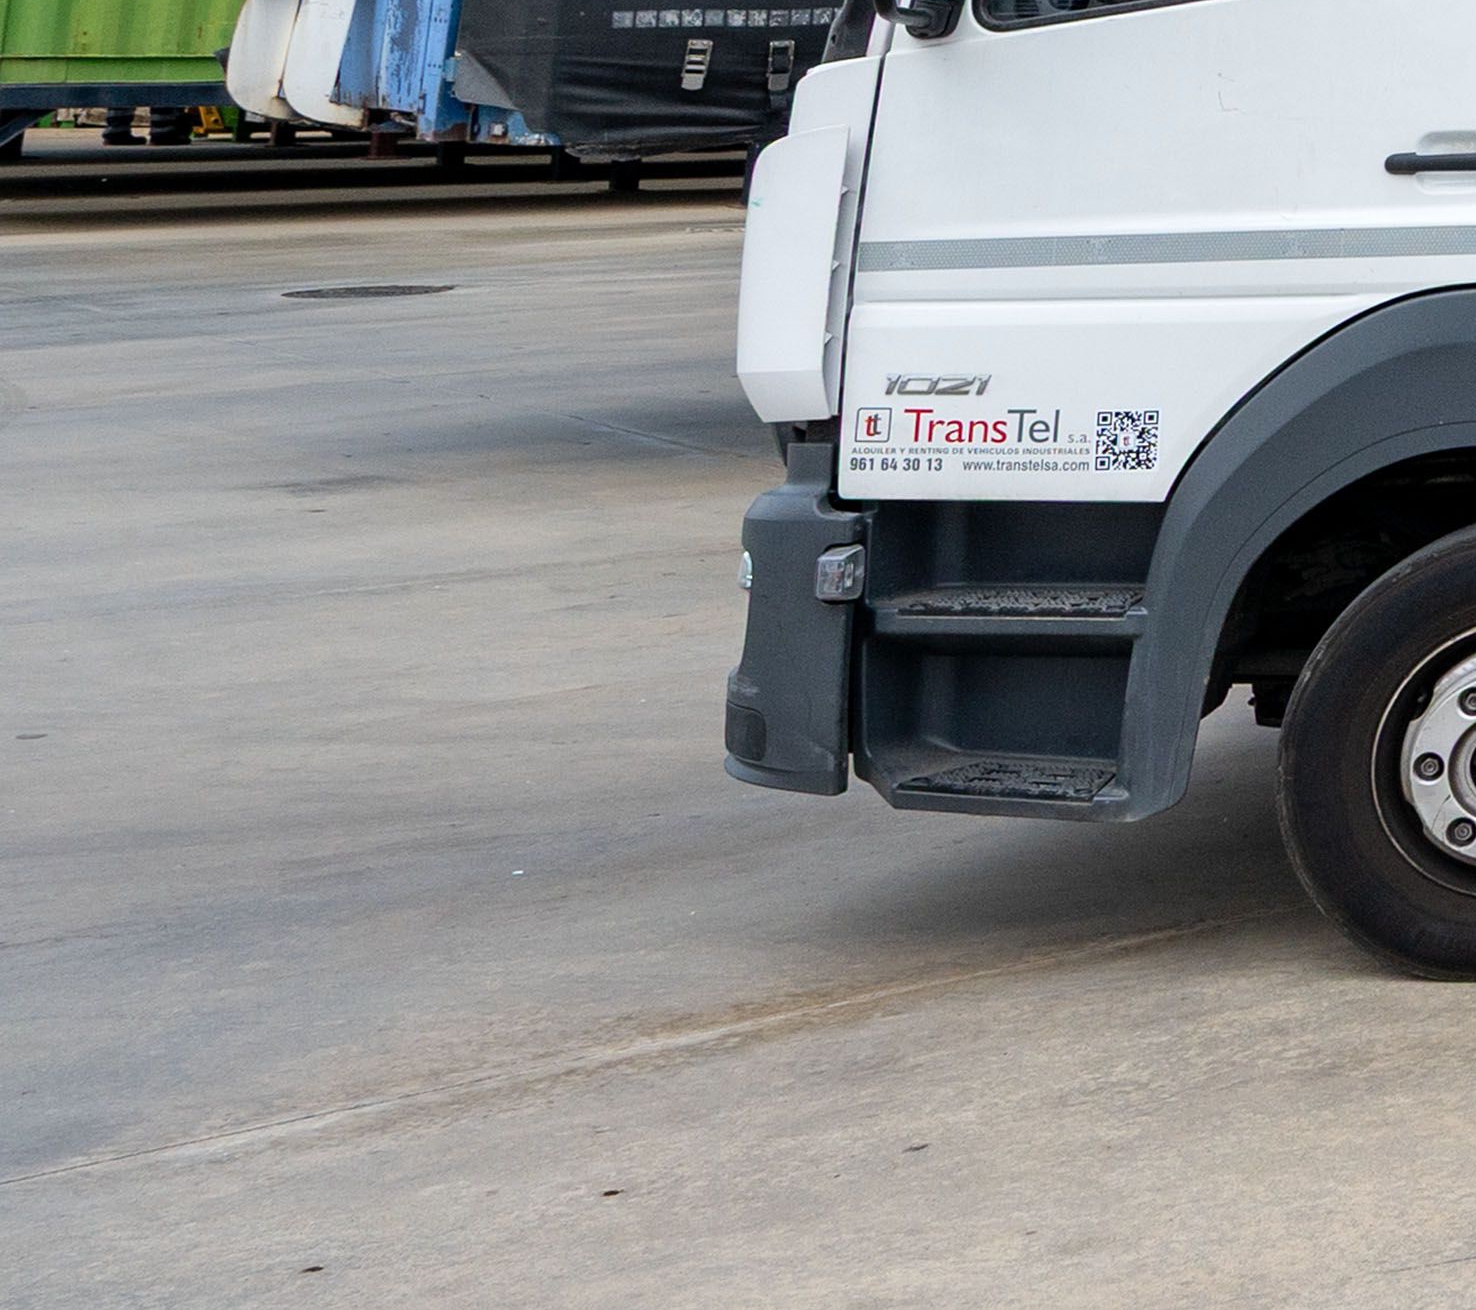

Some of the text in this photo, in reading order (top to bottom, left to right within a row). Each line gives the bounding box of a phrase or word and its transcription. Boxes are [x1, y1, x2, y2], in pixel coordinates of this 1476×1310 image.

[884, 373, 992, 395] 1021
[904, 409, 1060, 442] TransTel
[1067, 434, 1091, 443] s.a.
[852, 447, 1090, 455] ALQUILER Y RENTING DE VEHICULOS INDUSTRIALES
[850, 457, 943, 471] 961 64 30 13
[962, 459, 1090, 472] www.transtelsa.com
